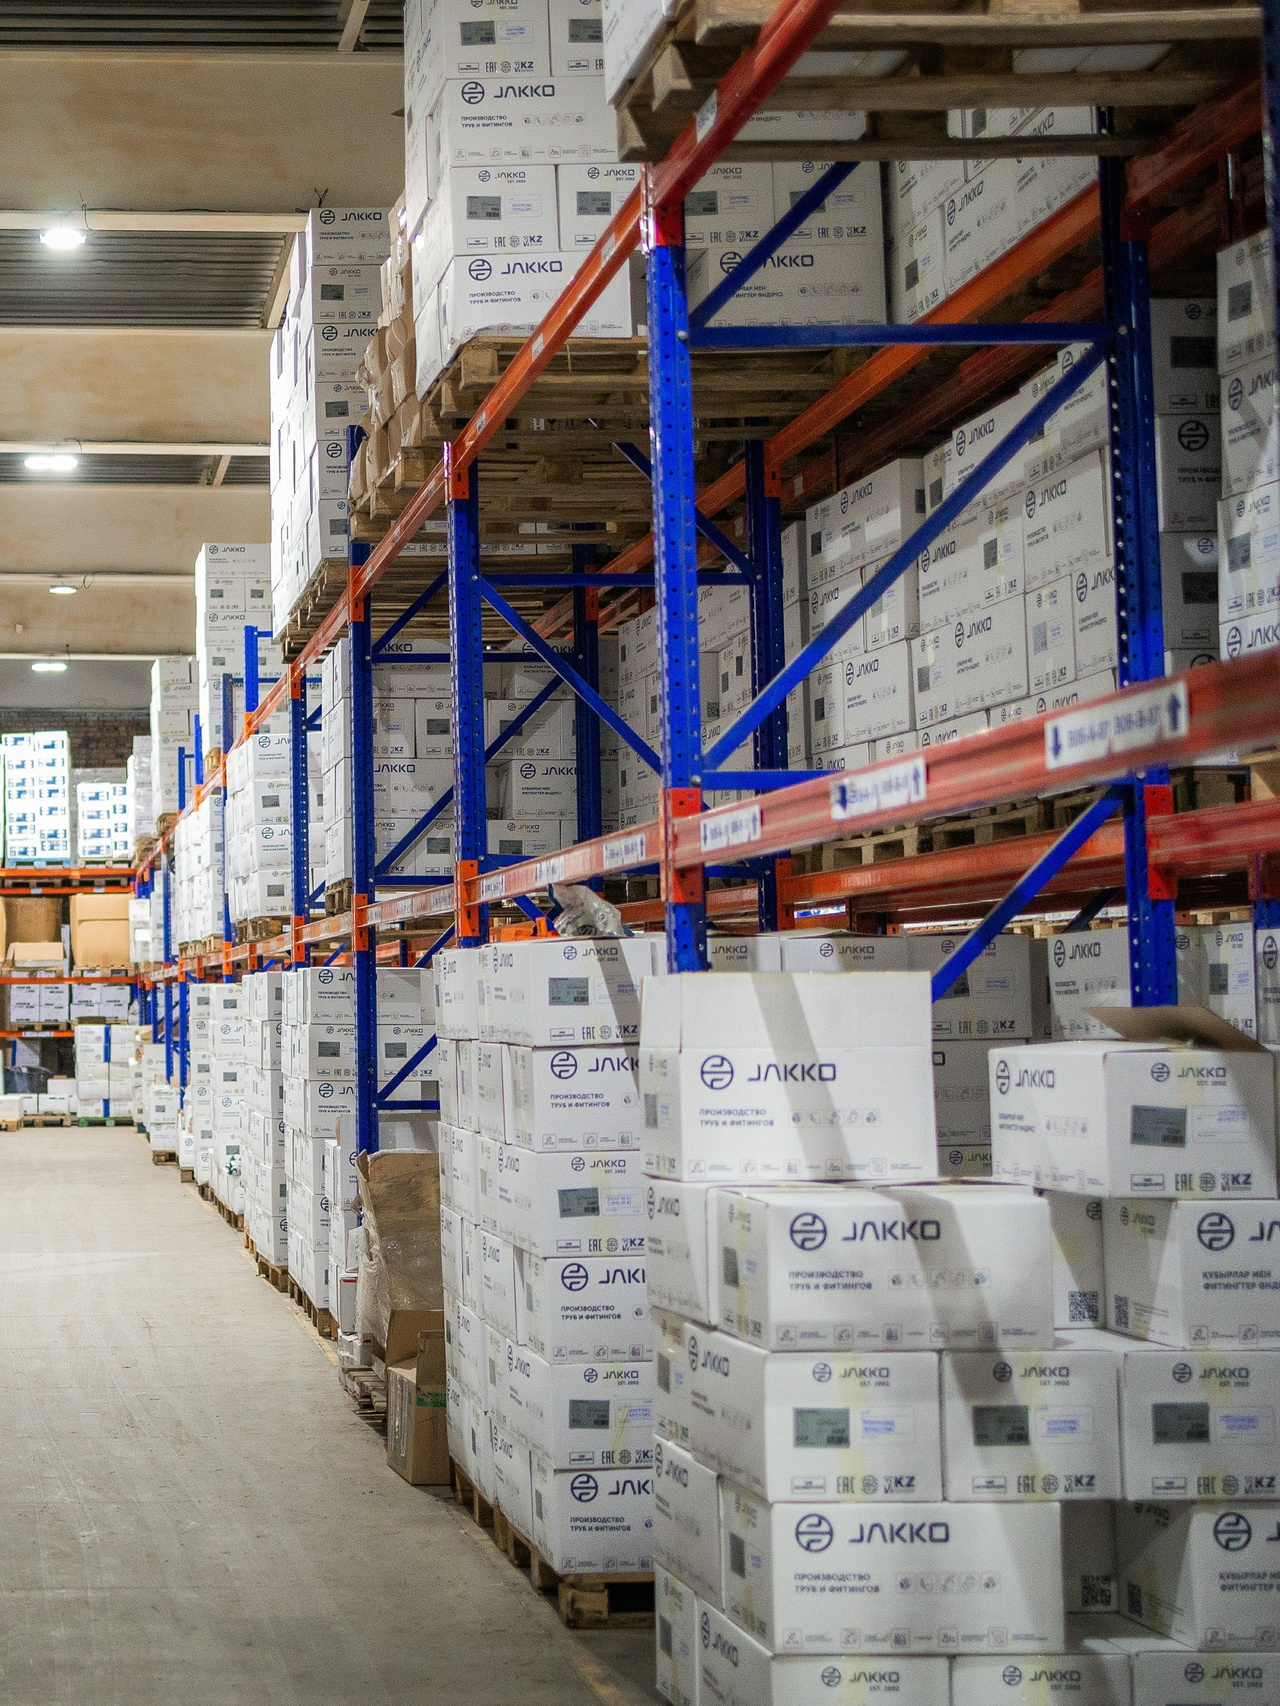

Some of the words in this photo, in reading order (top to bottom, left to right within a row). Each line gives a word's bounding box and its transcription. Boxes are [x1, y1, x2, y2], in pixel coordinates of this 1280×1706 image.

[493, 85, 555, 98] JAKKO
[959, 180, 984, 212] JAKKO
[341, 212, 382, 221] JAKKO
[529, 235, 542, 243] KZ
[501, 261, 562, 274] JAKKO
[1039, 481, 1066, 508] JAKKO
[967, 617, 991, 639] JAKKO
[856, 659, 878, 681] JAKKO
[373, 764, 415, 773] JAKKO
[582, 948, 618, 956] JAKKO
[712, 945, 748, 955] JAKKO
[838, 947, 874, 955] JAKKO
[1069, 942, 1100, 962] JAKKO
[624, 1025, 638, 1034] KZ
[1000, 1020, 1014, 1029] KZ
[747, 1063, 836, 1081] JAKKO
[1177, 1067, 1226, 1078] JAKKO
[1015, 1070, 1054, 1089] JAKKO
[550, 1093, 603, 1101] ПРОИЗВОДСТВО
[590, 1160, 626, 1168] JAKKO
[1231, 1173, 1252, 1186] KZ
[842, 1220, 940, 1241] JAKKO
[630, 1238, 644, 1247] KZ
[603, 1370, 638, 1379] JAKKO
[840, 1367, 889, 1378] JAKKO
[1019, 1366, 1069, 1377] JAKKO
[1199, 1367, 1249, 1379] JAKKO
[894, 1475, 915, 1487] KZ
[1074, 1475, 1095, 1487] KZ
[1255, 1475, 1276, 1487] KZ
[595, 1524, 631, 1532] ФИТИНГОВ
[849, 1522, 949, 1543] JAKKO
[794, 1573, 870, 1581] ПРОИЗВОДСТВО
[848, 1671, 899, 1683] JAKKO
[1028, 1671, 1081, 1682] JAKKO
[1212, 1668, 1262, 1679] JAKKO
